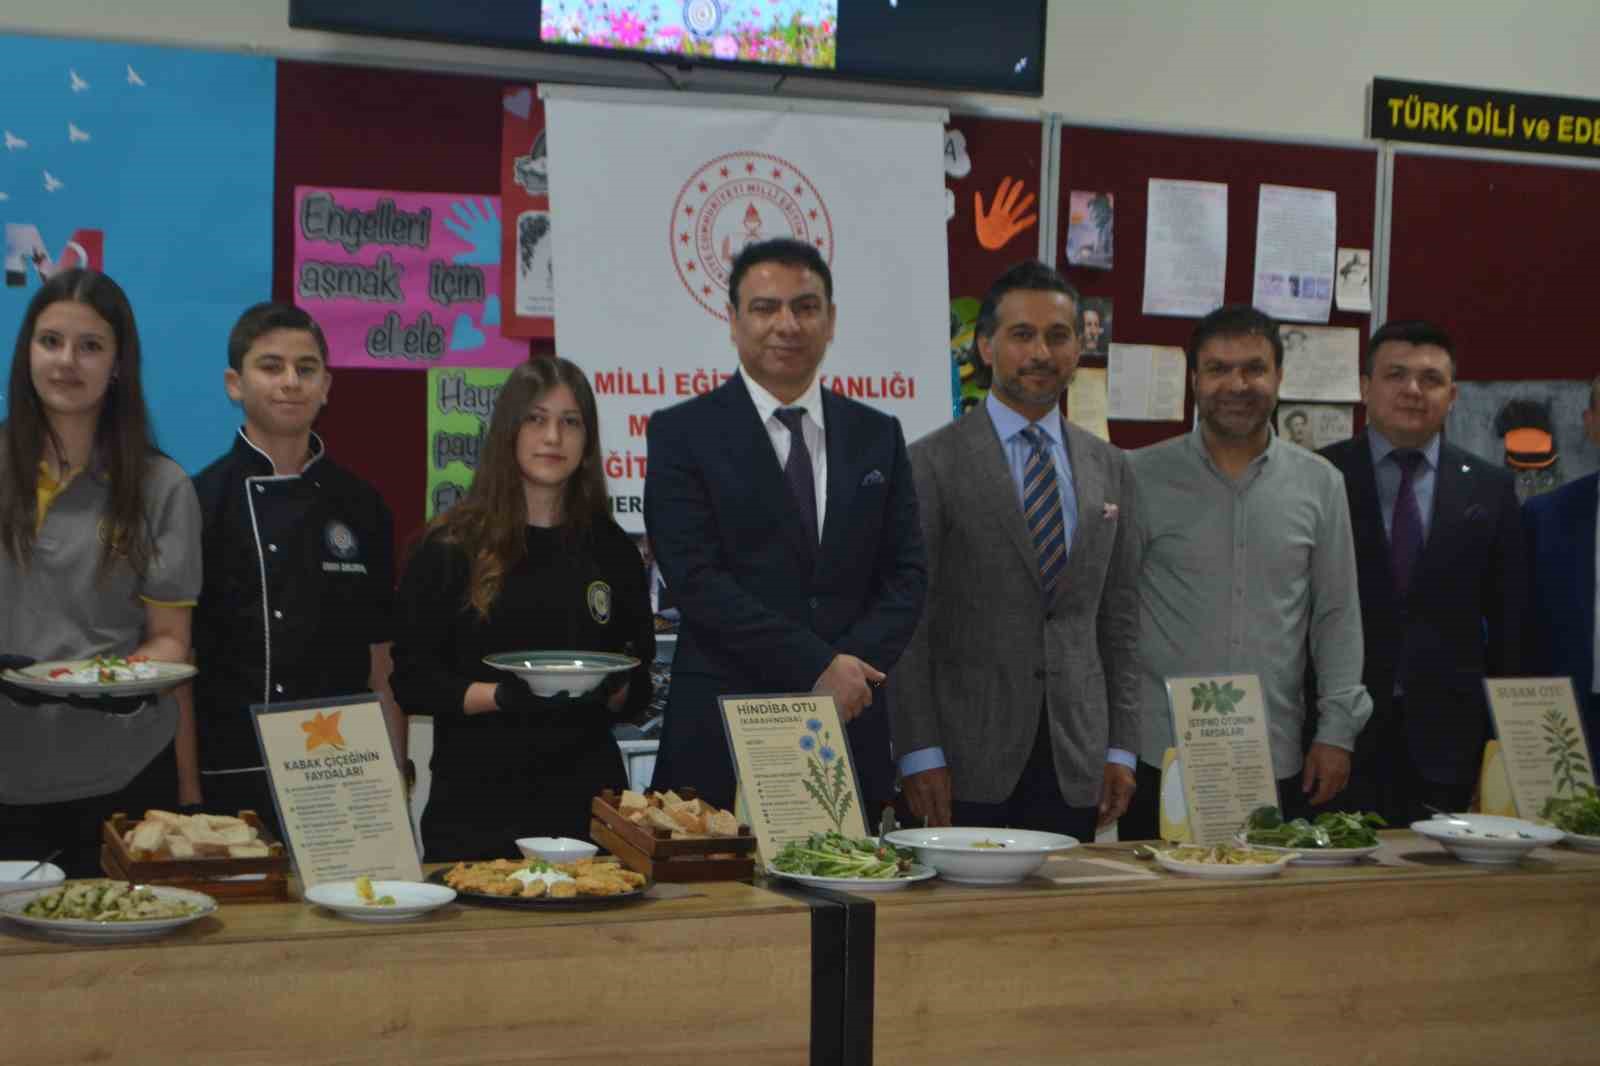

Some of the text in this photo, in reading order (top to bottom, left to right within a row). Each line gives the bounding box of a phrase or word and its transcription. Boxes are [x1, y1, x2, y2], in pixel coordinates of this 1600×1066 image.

[1388, 94, 1459, 131] TÜRK
[1466, 101, 1516, 137] DİLİ
[1522, 117, 1550, 141] ve
[303, 194, 430, 251] Engelleri
[302, 256, 400, 300] aşmak
[431, 262, 484, 303] için
[369, 313, 444, 356] el ele
[595, 367, 665, 396] MİLLİ
[737, 701, 817, 715] HİNDİBA OTU
[284, 756, 322, 772] KABAK
[304, 766, 364, 782] FAYDALARI
